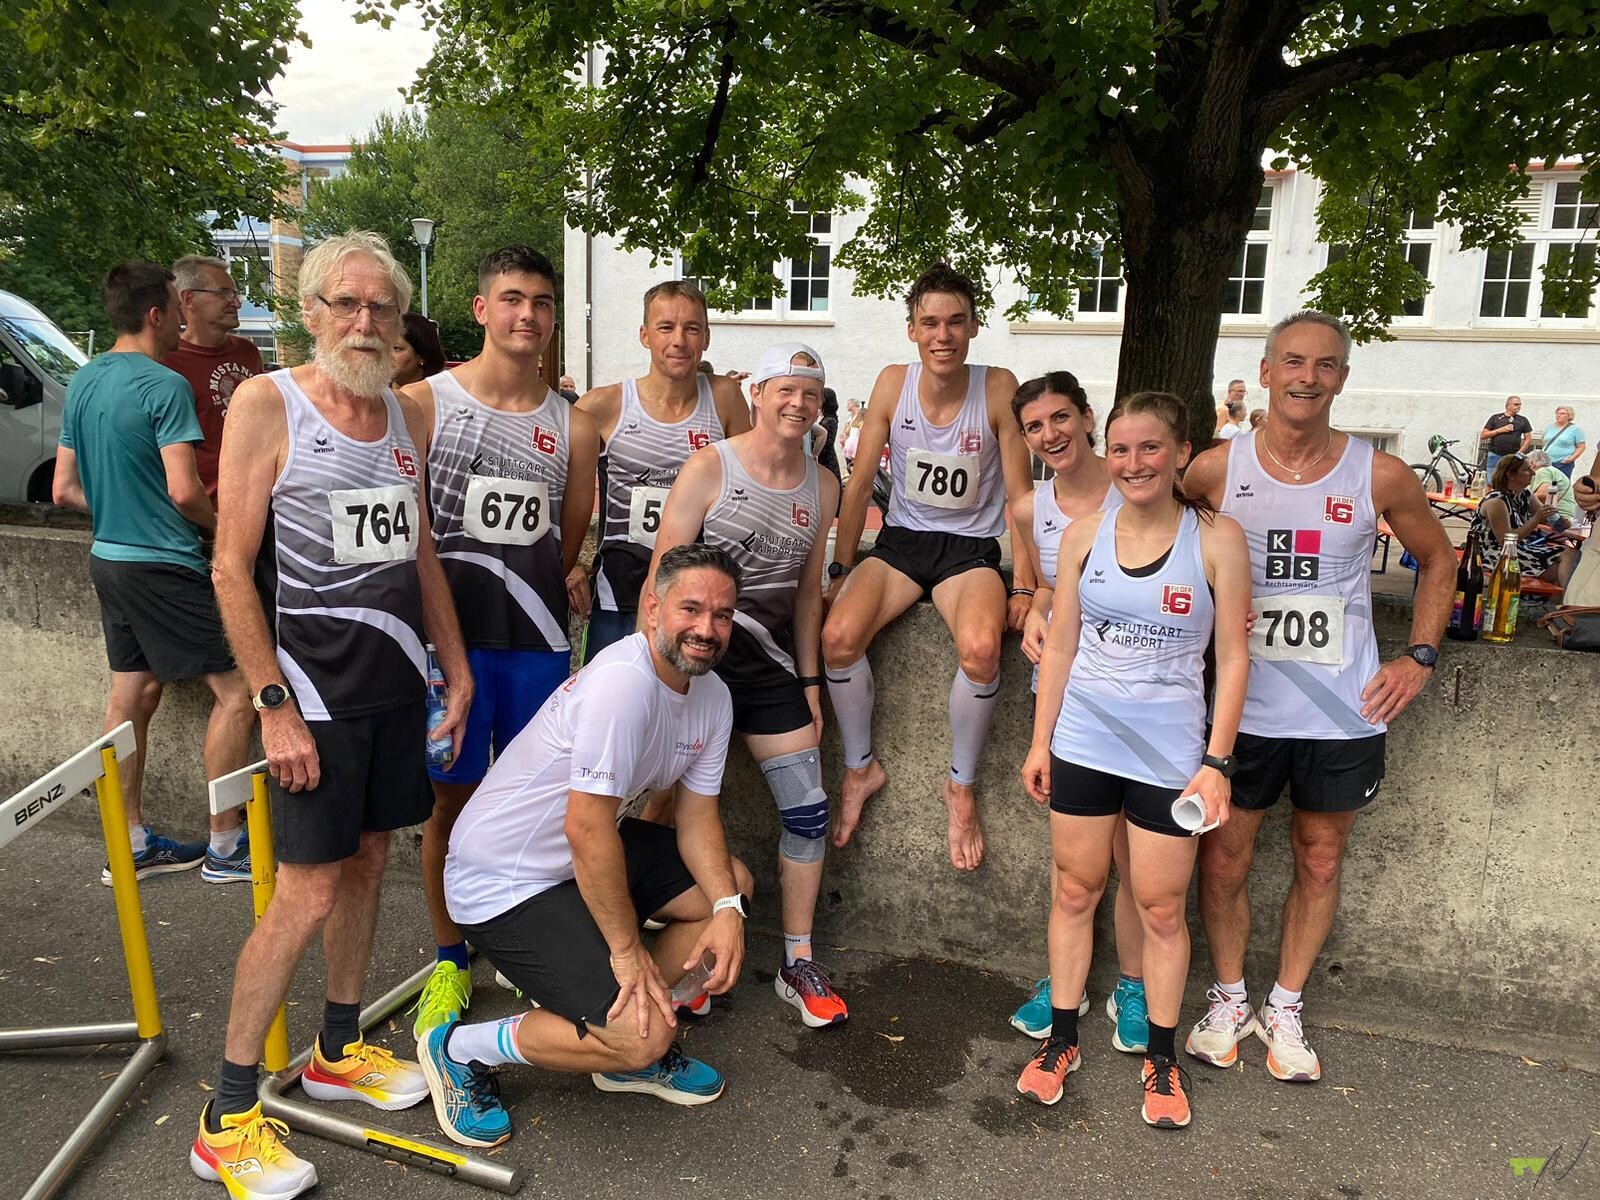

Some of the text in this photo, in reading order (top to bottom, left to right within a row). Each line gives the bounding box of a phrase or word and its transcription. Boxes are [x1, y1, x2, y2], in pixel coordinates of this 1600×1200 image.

[487, 456, 547, 475] STUTTGART
[487, 468, 531, 481] AIRPORT
[916, 461, 968, 498] 780
[1333, 496, 1354, 505] FILDER
[481, 491, 541, 532] 678
[345, 500, 410, 547] 764
[760, 534, 808, 548] STUTTGART
[756, 545, 796, 557] AIRPORT
[1171, 585, 1193, 593] FILDER
[1115, 622, 1183, 638] STUTTGART
[1262, 610, 1330, 648] 708
[1112, 635, 1164, 649] AIRPORT
[14, 783, 63, 827] BENZ
